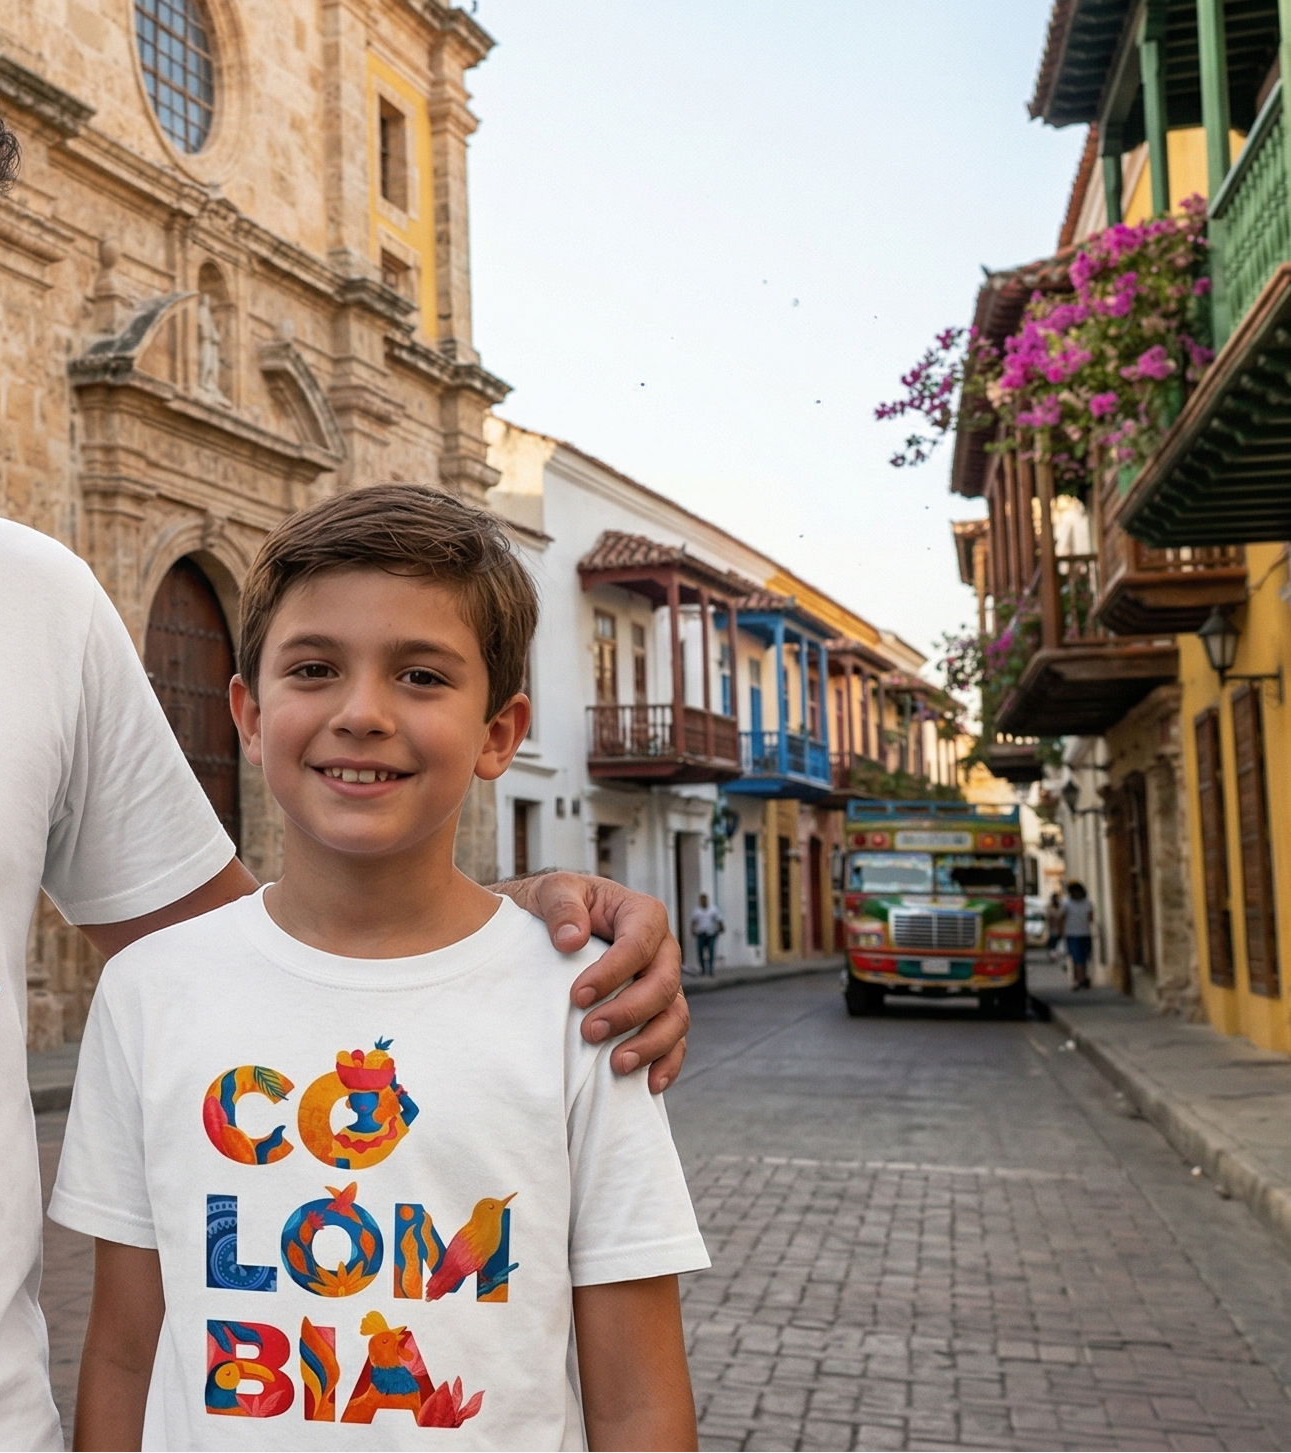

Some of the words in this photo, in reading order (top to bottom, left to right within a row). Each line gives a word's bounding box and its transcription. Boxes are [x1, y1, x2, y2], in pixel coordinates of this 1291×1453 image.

[202, 1046, 419, 1170] CO
[205, 1184, 519, 1303] LOM
[204, 1312, 486, 1428] BIA
